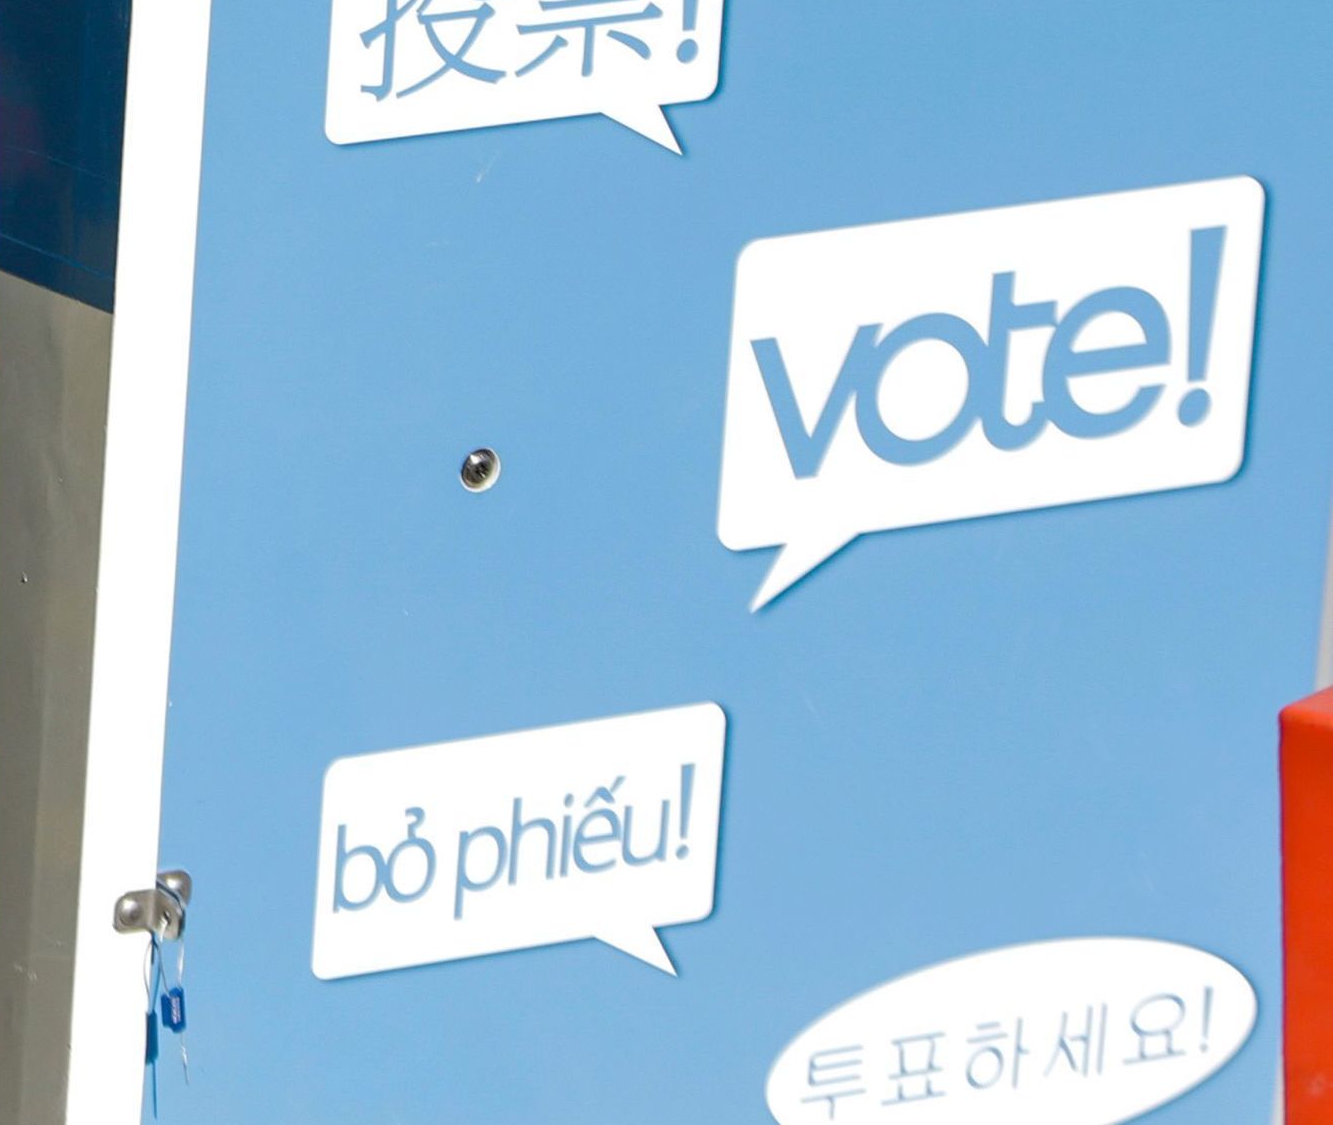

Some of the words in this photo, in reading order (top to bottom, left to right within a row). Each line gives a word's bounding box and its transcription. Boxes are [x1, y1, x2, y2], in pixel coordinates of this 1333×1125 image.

[751, 225, 1228, 480] vote!
[333, 807, 437, 913] bỏ
[454, 763, 696, 921] phiếu!
[799, 985, 1214, 1121] 투표하세요!
